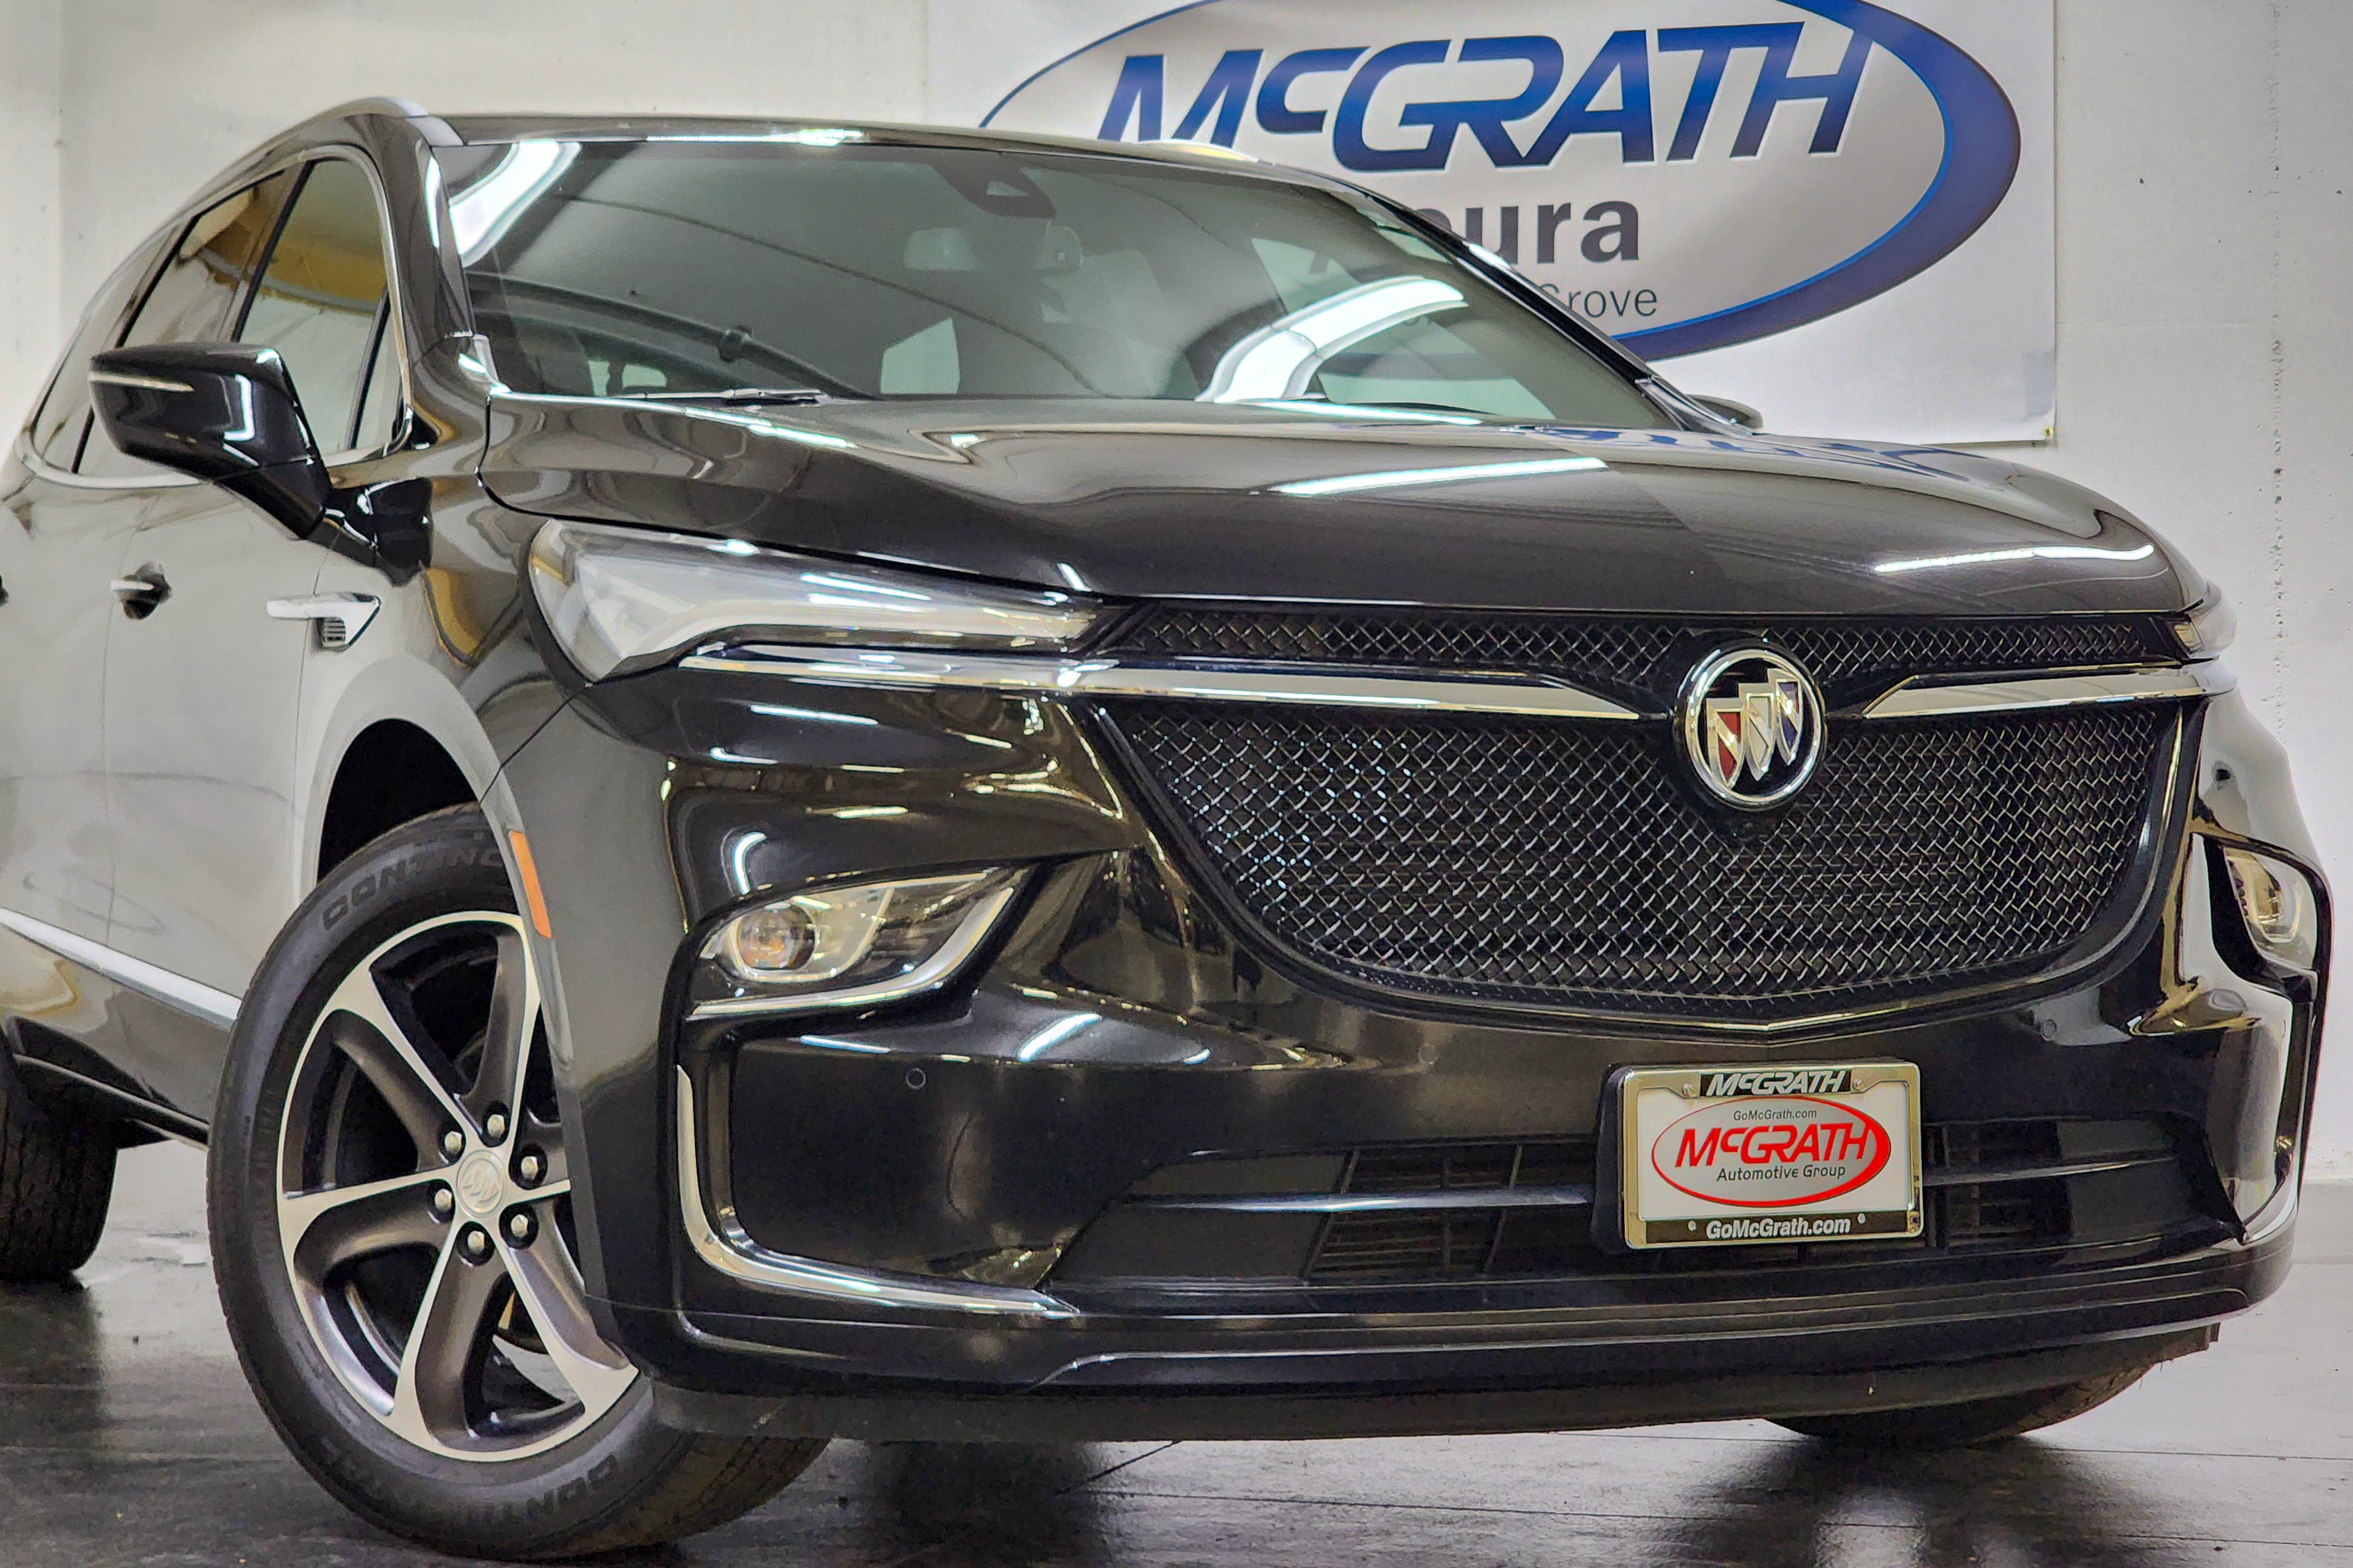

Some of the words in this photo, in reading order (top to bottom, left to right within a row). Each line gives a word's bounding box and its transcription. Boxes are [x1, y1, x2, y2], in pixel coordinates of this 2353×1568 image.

[1415, 201, 1640, 265] ura
[1733, 1109, 1817, 1120] GoMcGrath.com
[1717, 1165, 1798, 1181] Automotive
[1802, 1165, 1846, 1180] Group
[1706, 1217, 1850, 1239] GoMcGrath.com
